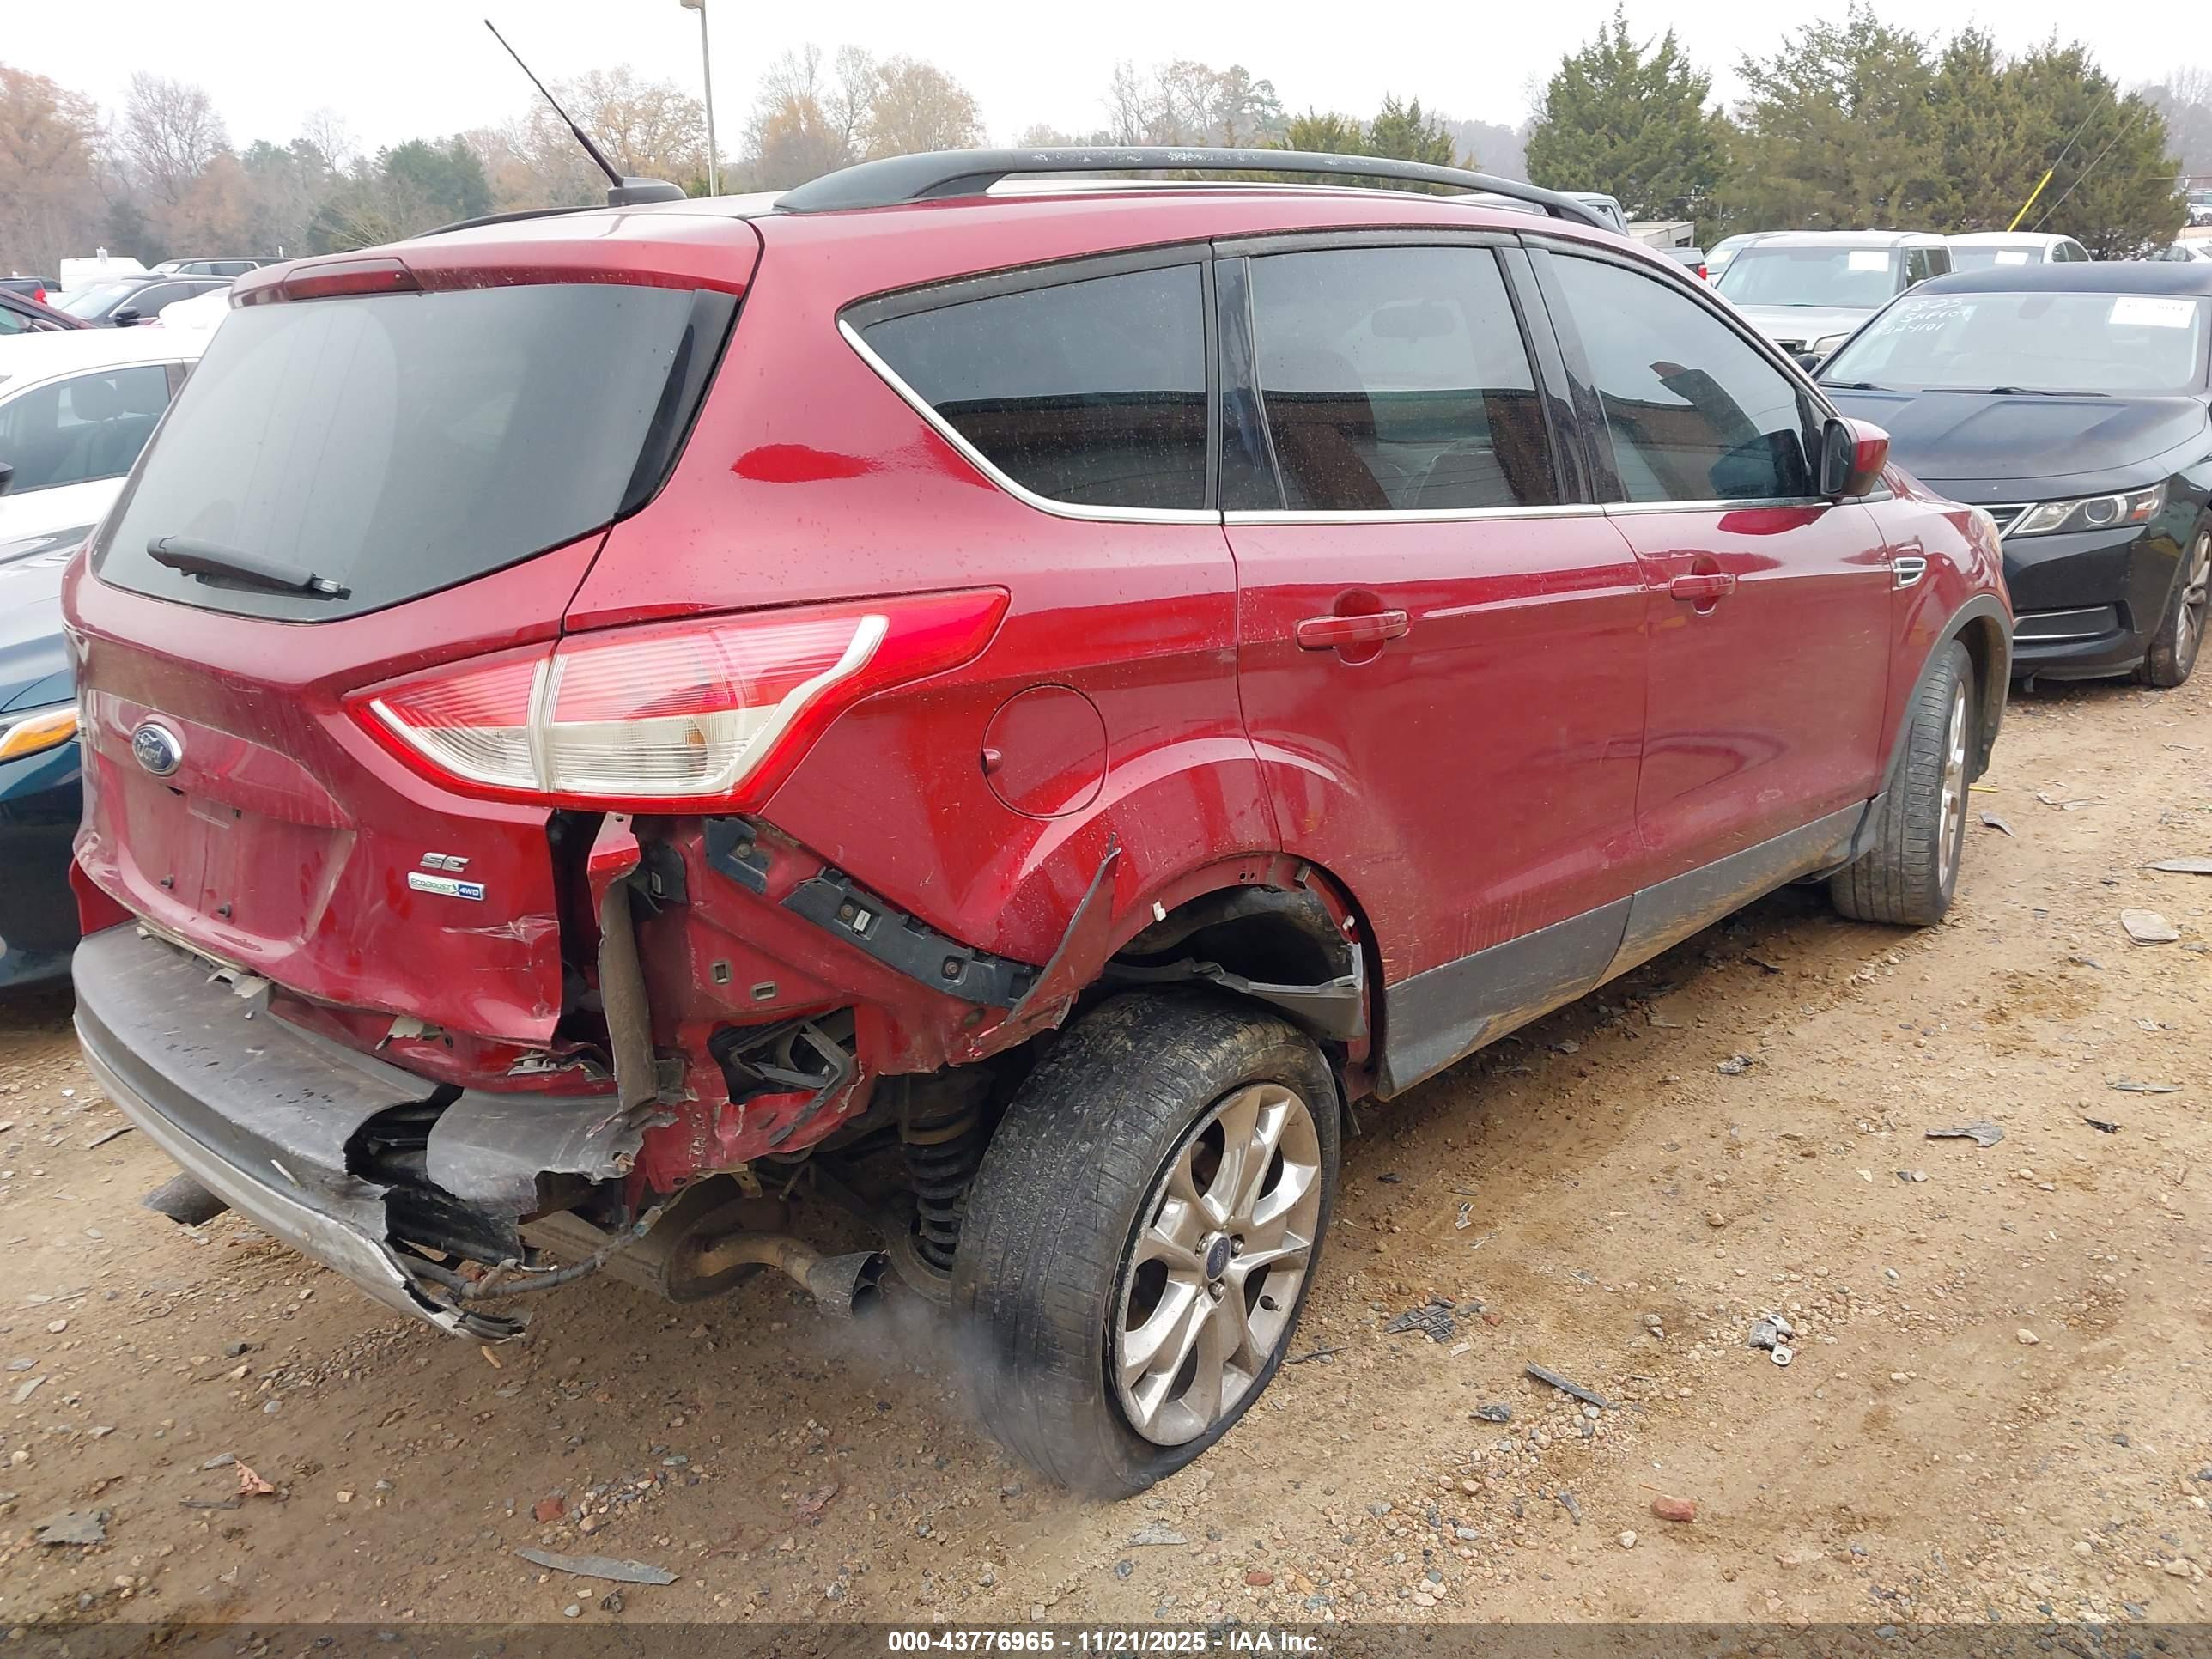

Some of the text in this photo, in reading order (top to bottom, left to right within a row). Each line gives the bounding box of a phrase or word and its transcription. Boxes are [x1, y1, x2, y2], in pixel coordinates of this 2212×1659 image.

[137, 732, 164, 764] Ford
[419, 852, 471, 873] SE
[459, 886, 479, 896] 4WD
